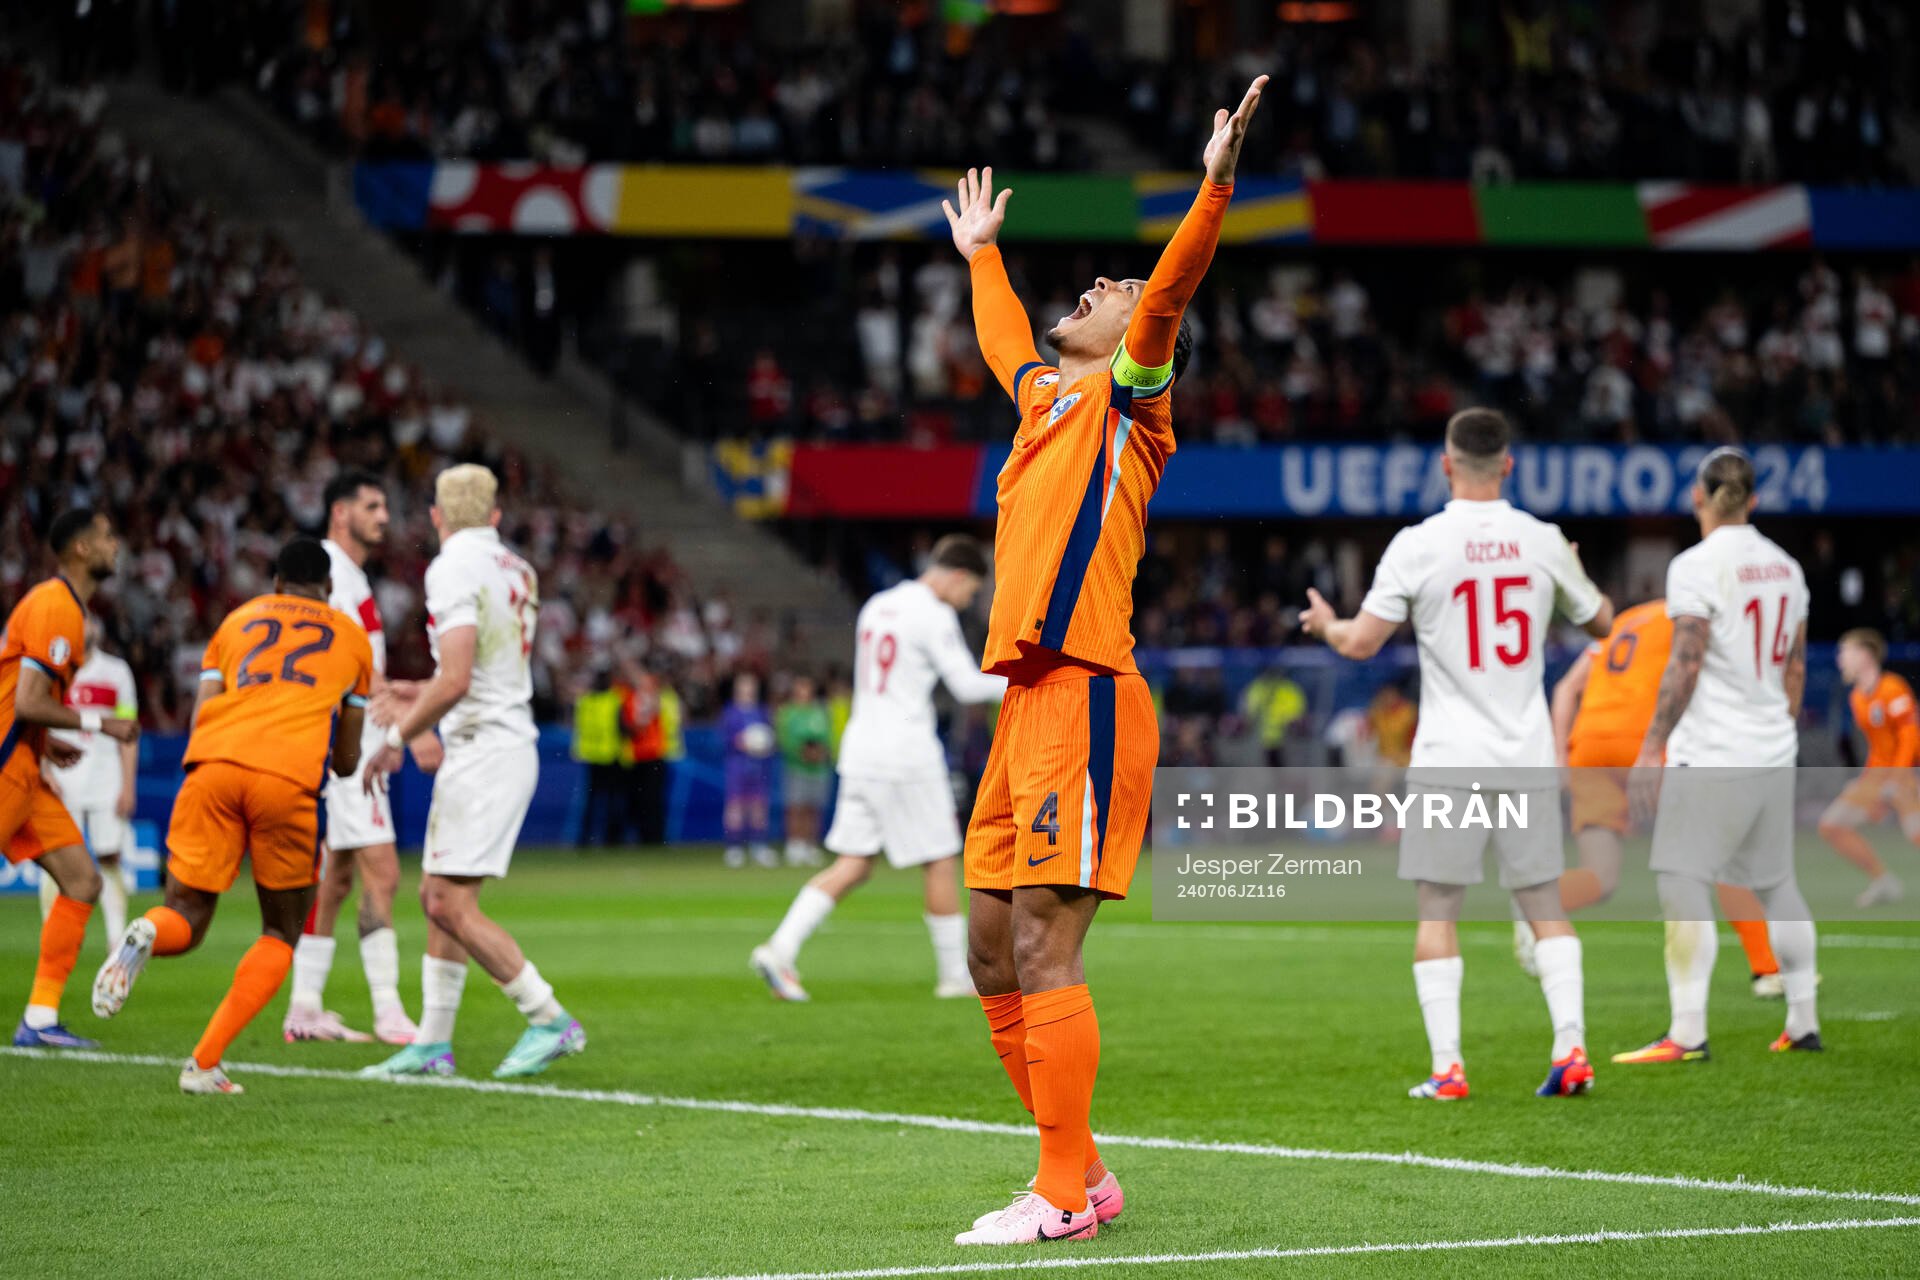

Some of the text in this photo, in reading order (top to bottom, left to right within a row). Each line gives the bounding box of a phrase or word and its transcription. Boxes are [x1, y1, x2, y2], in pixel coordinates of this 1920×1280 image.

[1500, 446, 1674, 515] URO
[1676, 446, 1829, 514] 224
[1465, 540, 1521, 563] ÖZCAN
[237, 618, 335, 689] 22
[1451, 575, 1532, 671] 15
[1744, 593, 1789, 682] 14
[1031, 791, 1061, 846] 4
